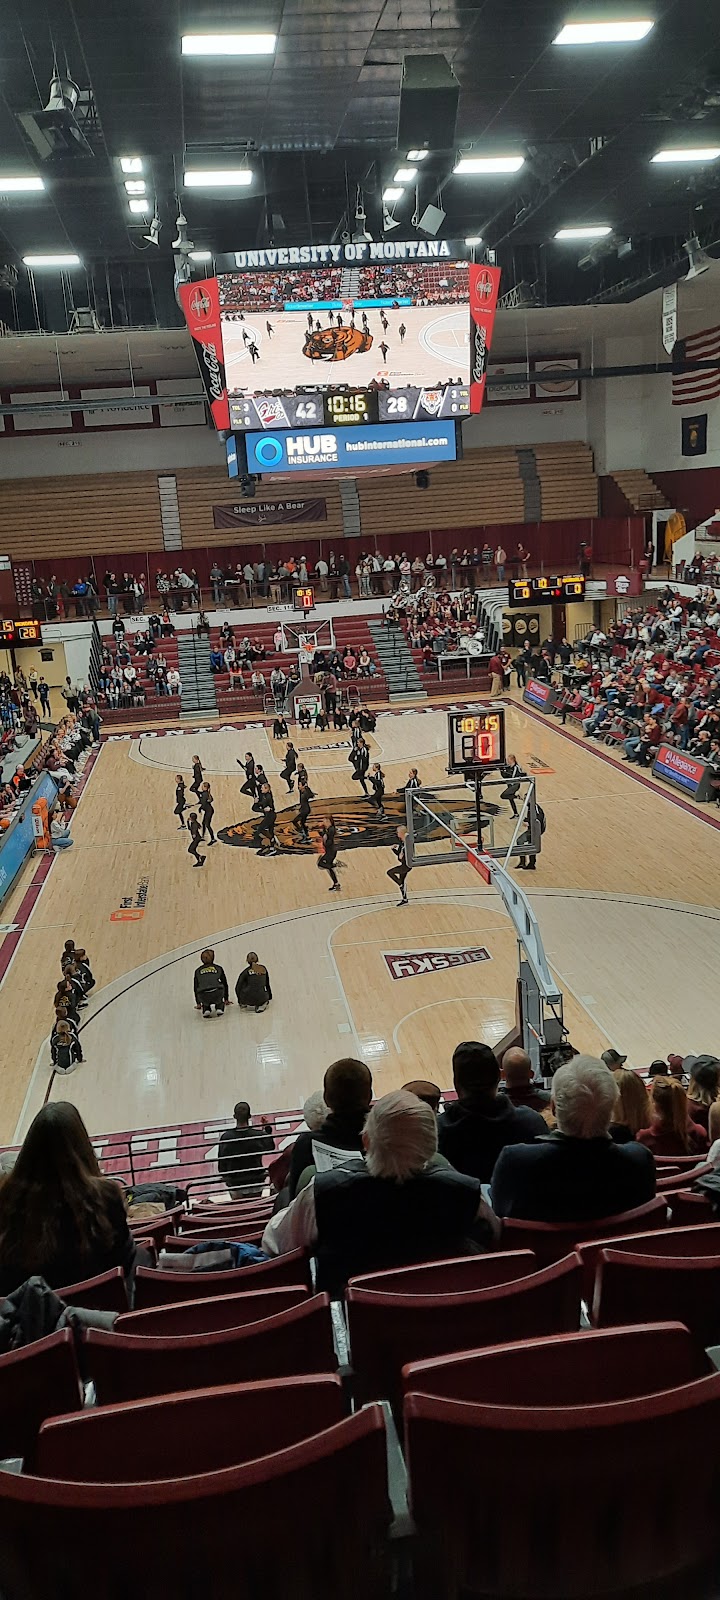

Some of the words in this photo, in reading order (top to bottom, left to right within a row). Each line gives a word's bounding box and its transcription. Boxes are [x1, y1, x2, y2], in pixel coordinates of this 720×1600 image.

[235, 245, 341, 268] UNIVERSITY
[345, 243, 363, 260] OF
[369, 240, 450, 259] MONTANA
[451, 390, 457, 399] 3
[243, 403, 249, 412] 3
[327, 394, 366, 413] 10:16
[387, 397, 407, 413] 28
[451, 403, 457, 412] 0
[295, 402, 317, 419] 42
[244, 417, 250, 425] 0
[333, 413, 360, 423] PERIOD
[363, 412, 368, 421] 1
[285, 434, 338, 456] HUB
[345, 437, 448, 452] hubinternational.com
[288, 453, 338, 465] INSURANCE
[233, 506, 257, 514] Sleep
[258, 503, 276, 512] Like
[22, 628, 36, 638] 28
[461, 715, 498, 733] 10:15
[477, 733, 493, 759] 0
